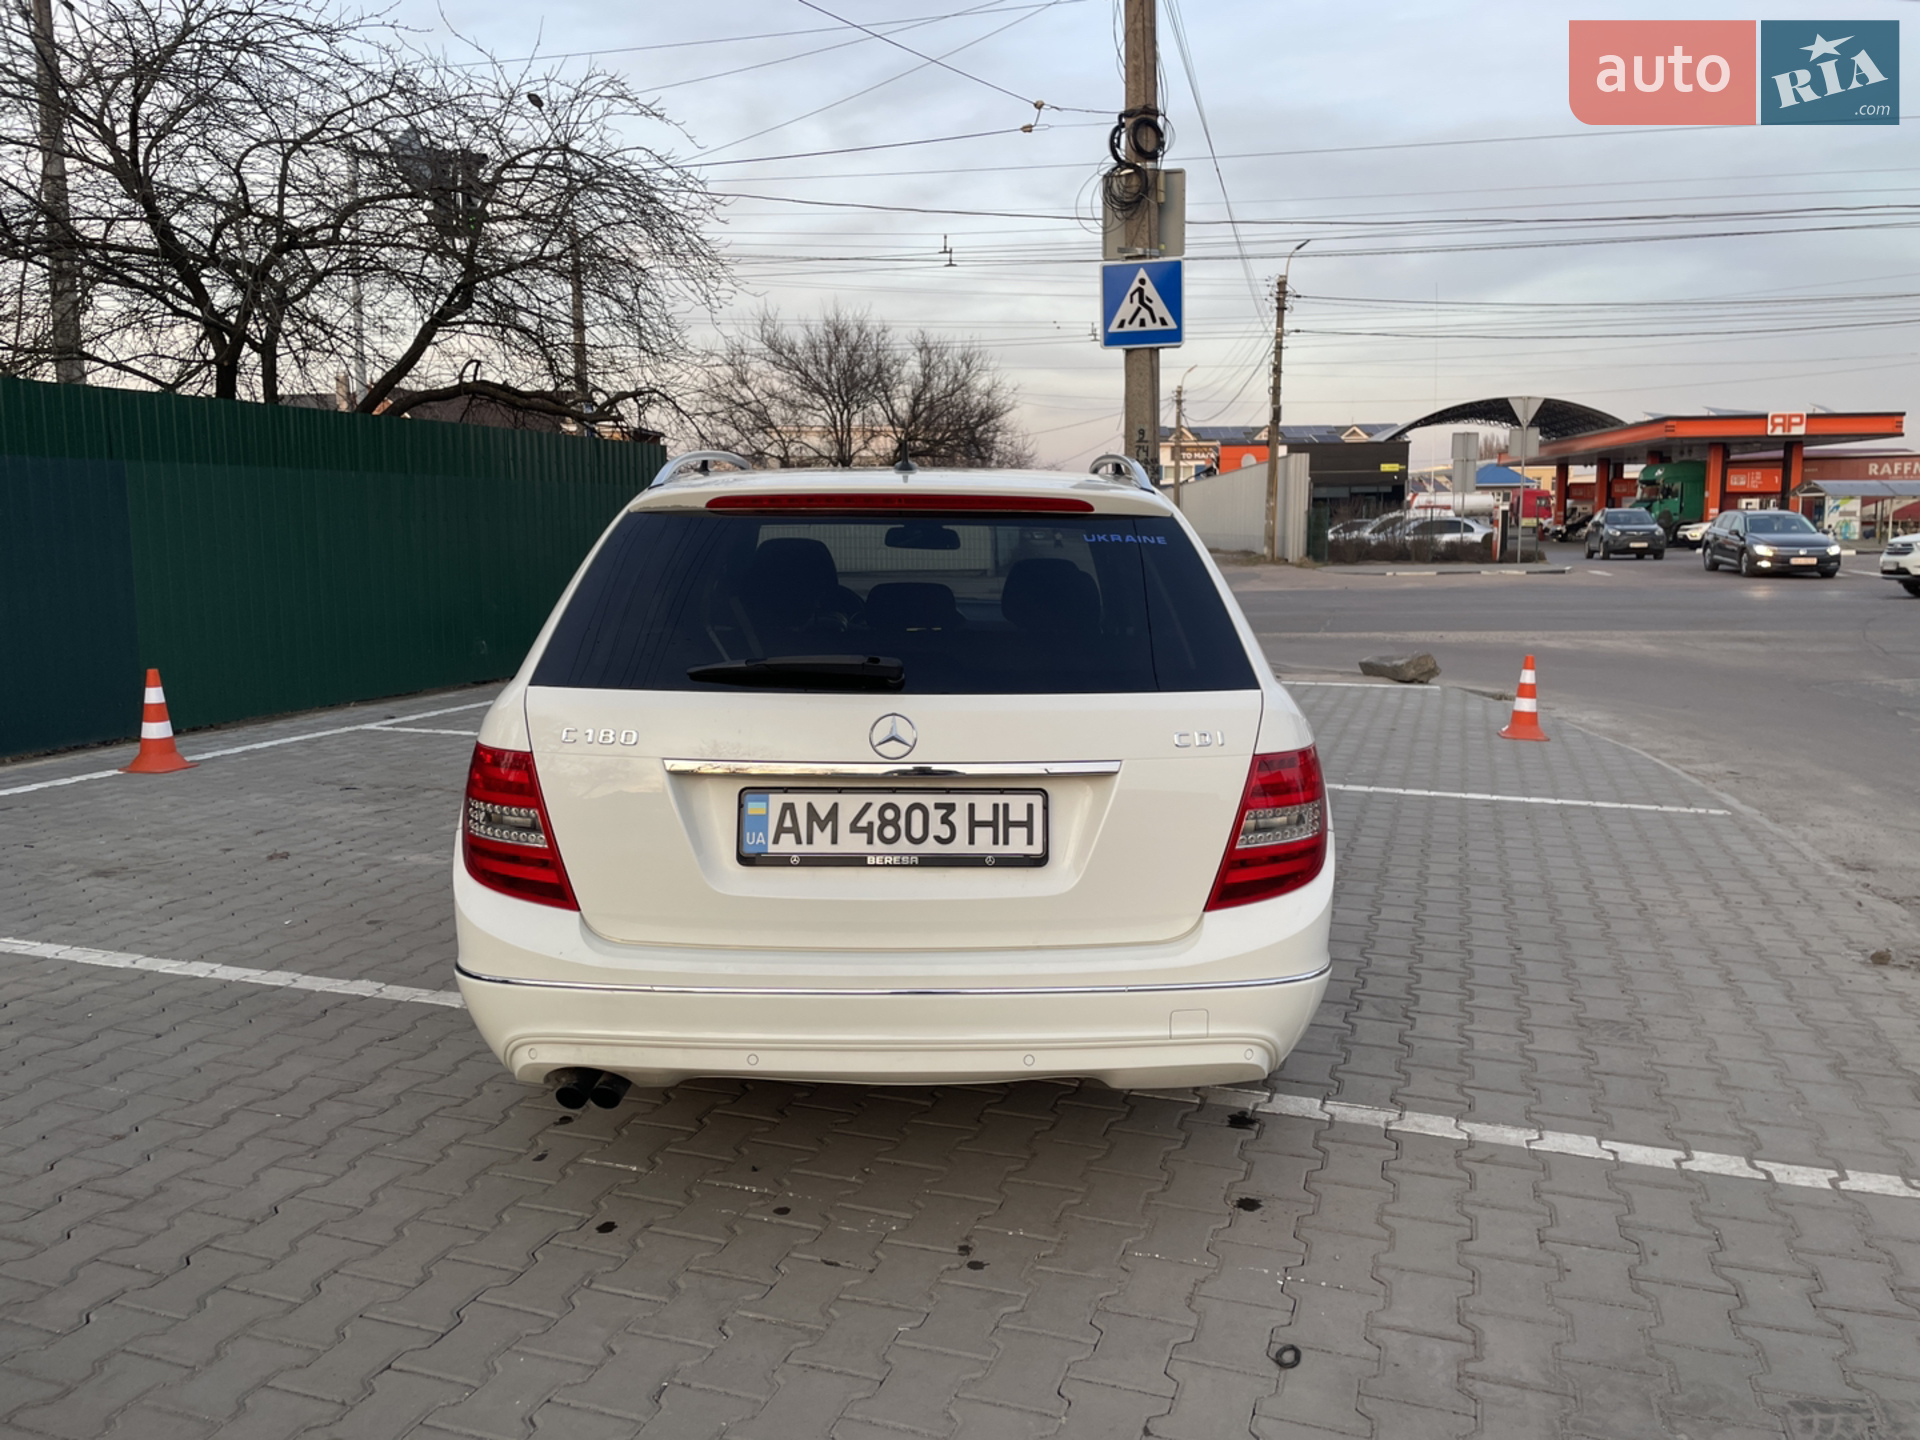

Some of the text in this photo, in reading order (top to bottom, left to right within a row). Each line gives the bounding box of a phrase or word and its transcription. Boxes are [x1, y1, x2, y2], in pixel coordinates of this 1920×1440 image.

[1083, 533, 1167, 545] UKRAINE
[561, 727, 639, 746] C 180
[1173, 731, 1225, 748] CDI
[771, 802, 1034, 846] AM 4803 HH
[746, 832, 766, 846] UA
[867, 856, 919, 866] BERESA
